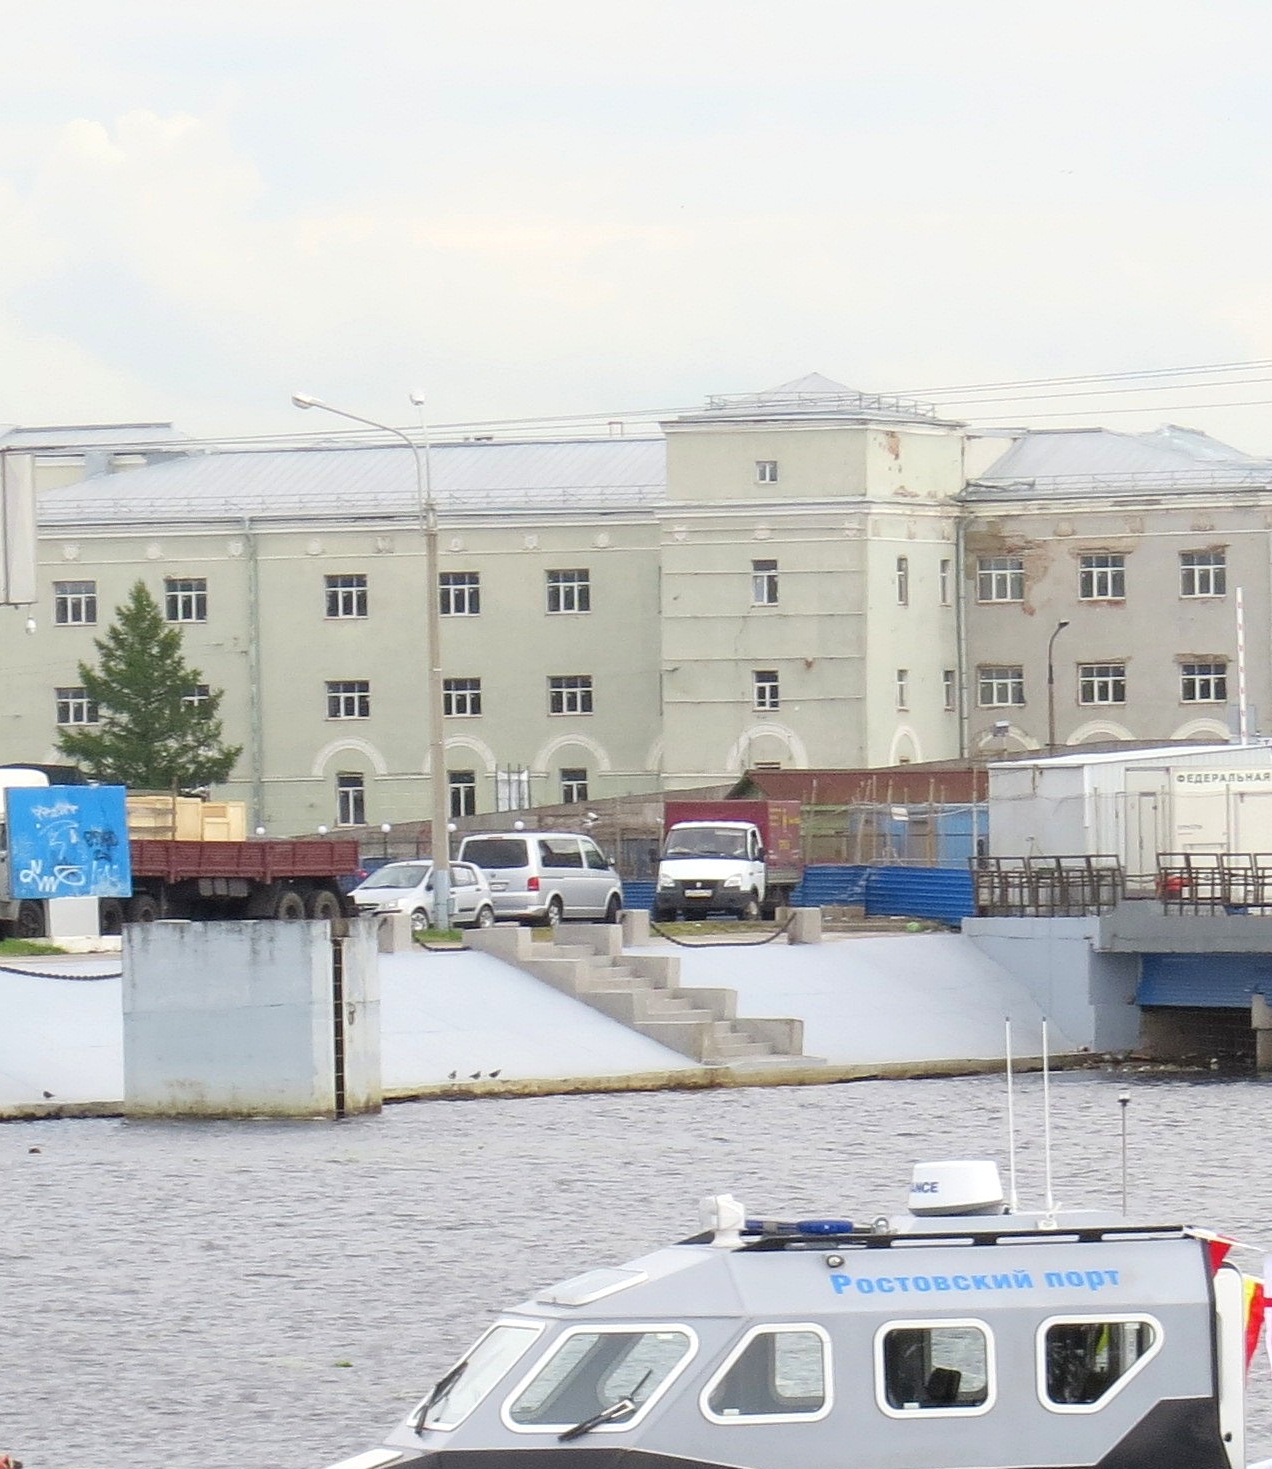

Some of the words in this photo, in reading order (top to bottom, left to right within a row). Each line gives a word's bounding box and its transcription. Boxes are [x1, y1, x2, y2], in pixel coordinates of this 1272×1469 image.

[1176, 772, 1271, 784] ФЕДЕРАЛЬНАЯ
[829, 1269, 1033, 1295] Ростовский
[1044, 1269, 1120, 1291] порт
